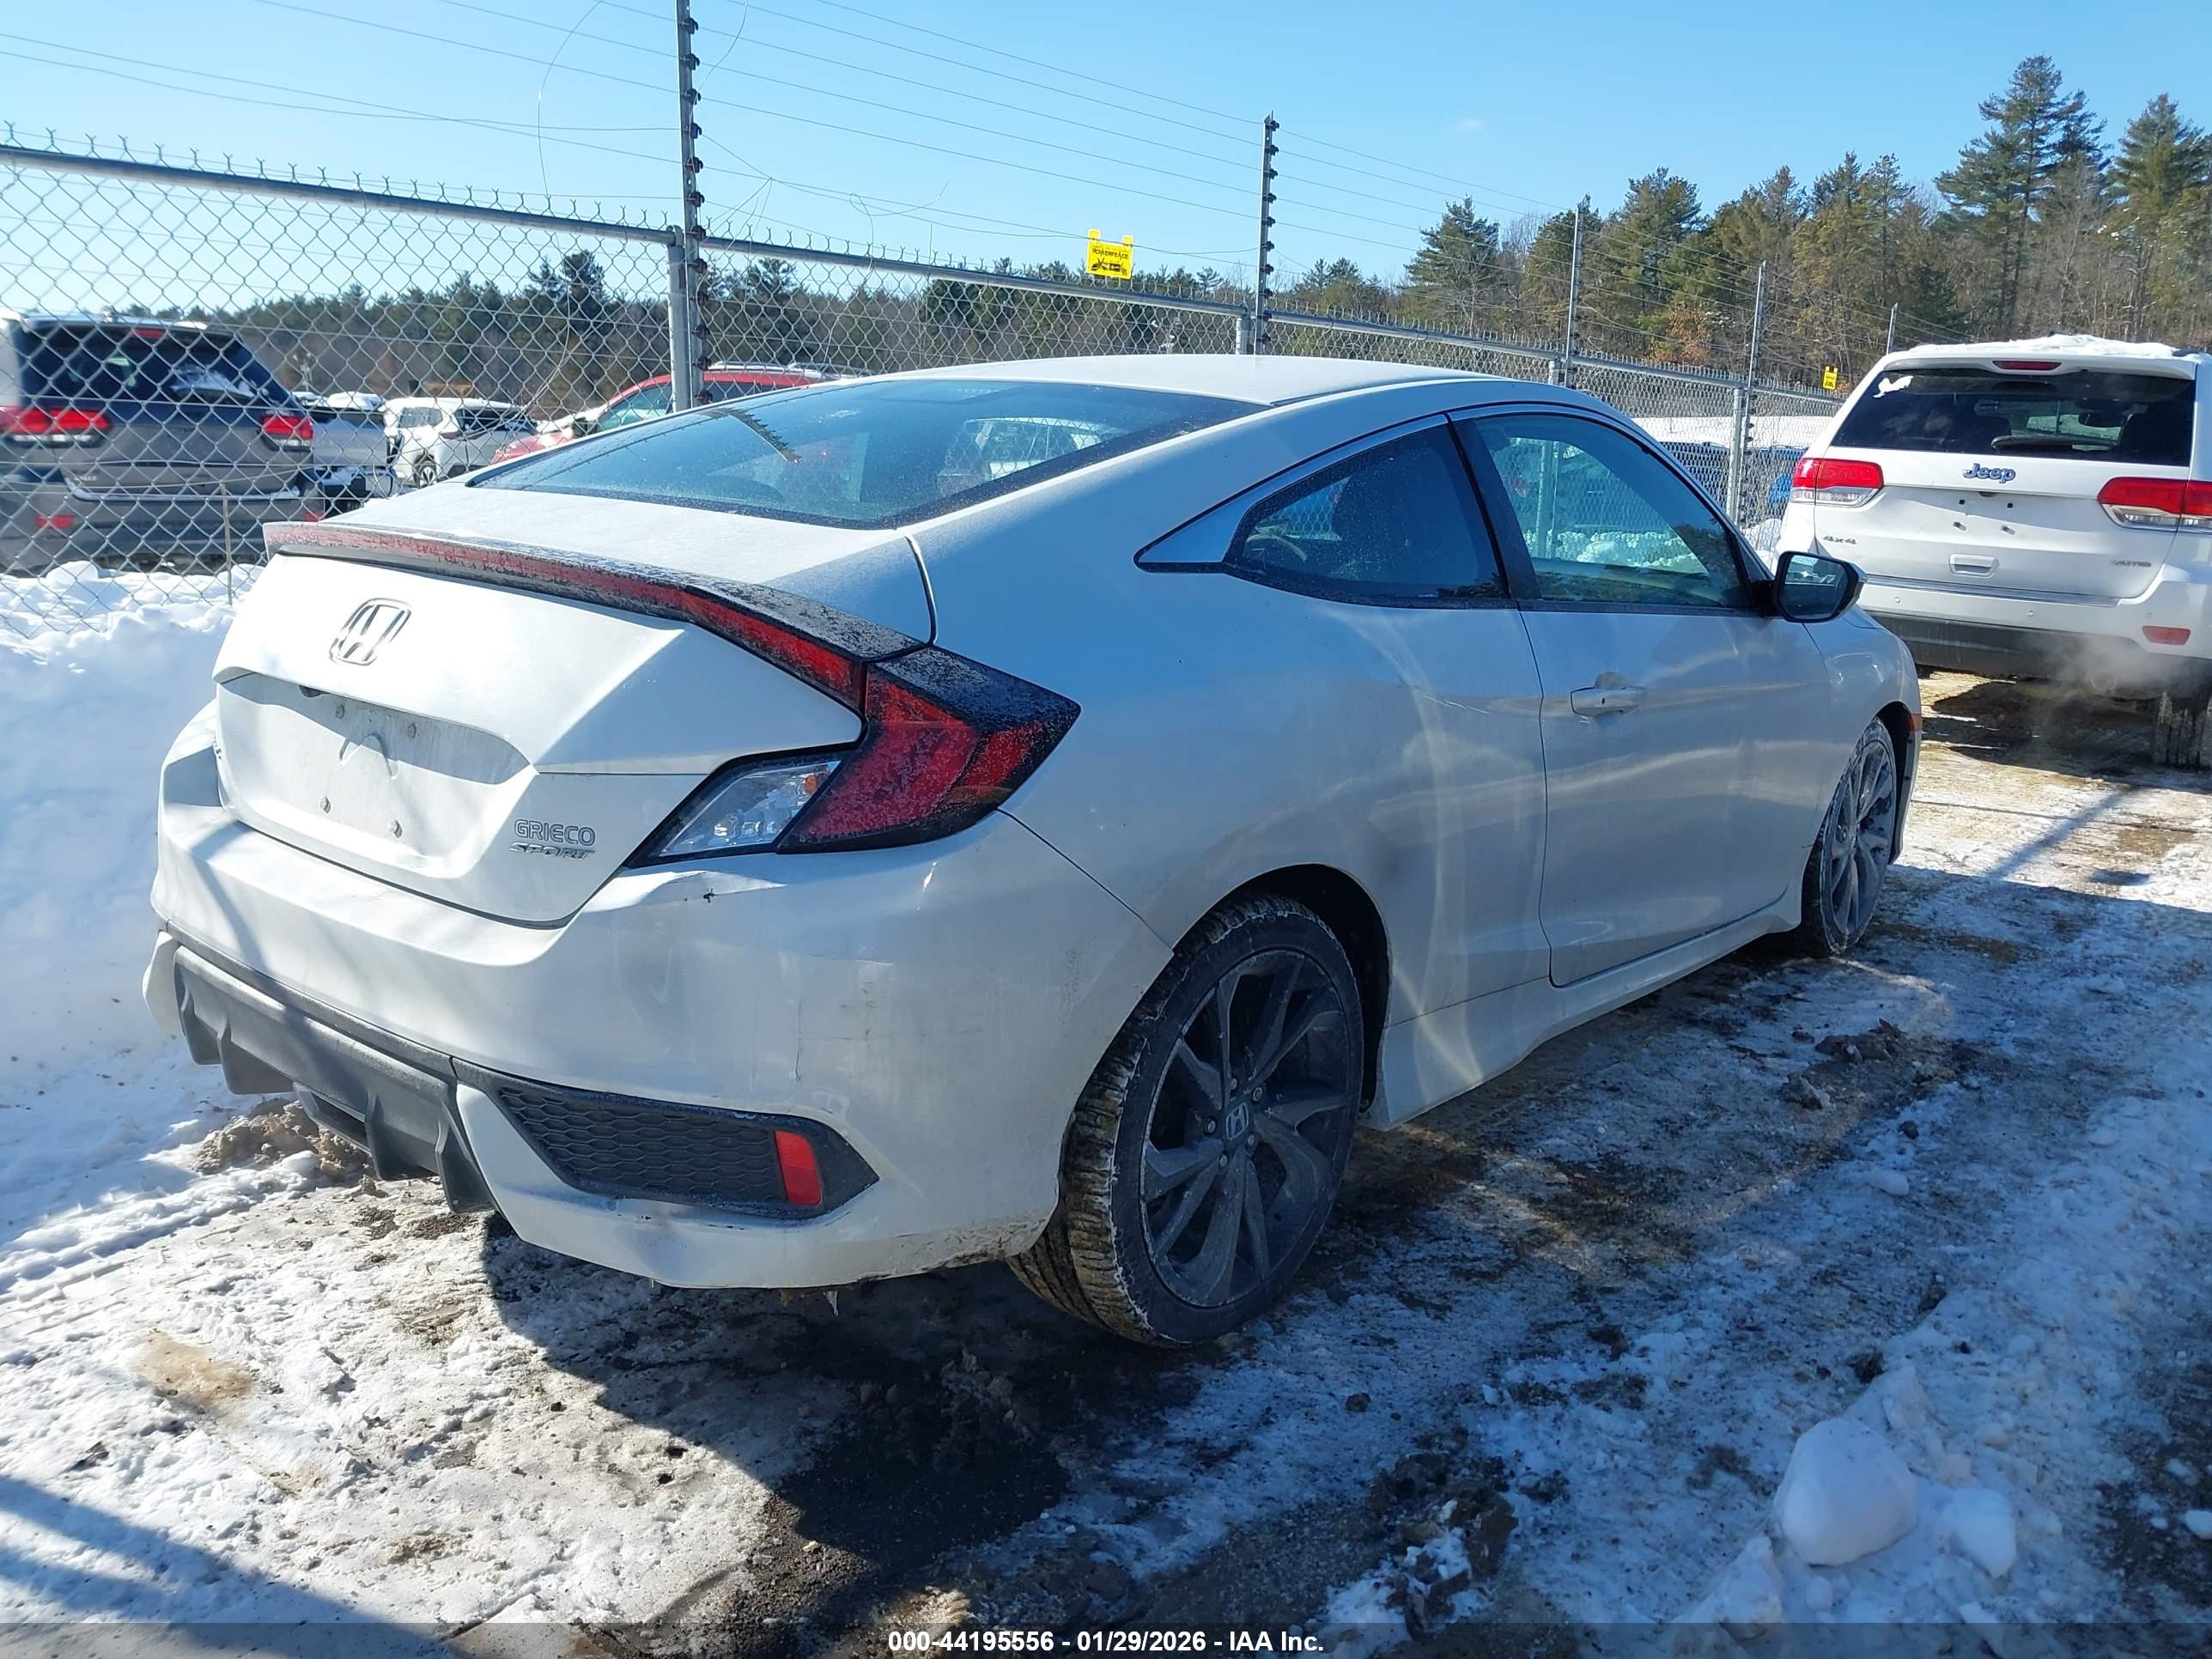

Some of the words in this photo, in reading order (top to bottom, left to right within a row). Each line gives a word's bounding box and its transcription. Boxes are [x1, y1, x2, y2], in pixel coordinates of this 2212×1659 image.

[1963, 463, 2016, 483] Jeep
[514, 818, 596, 847] GRIECO
[508, 842, 596, 860] SPORT
